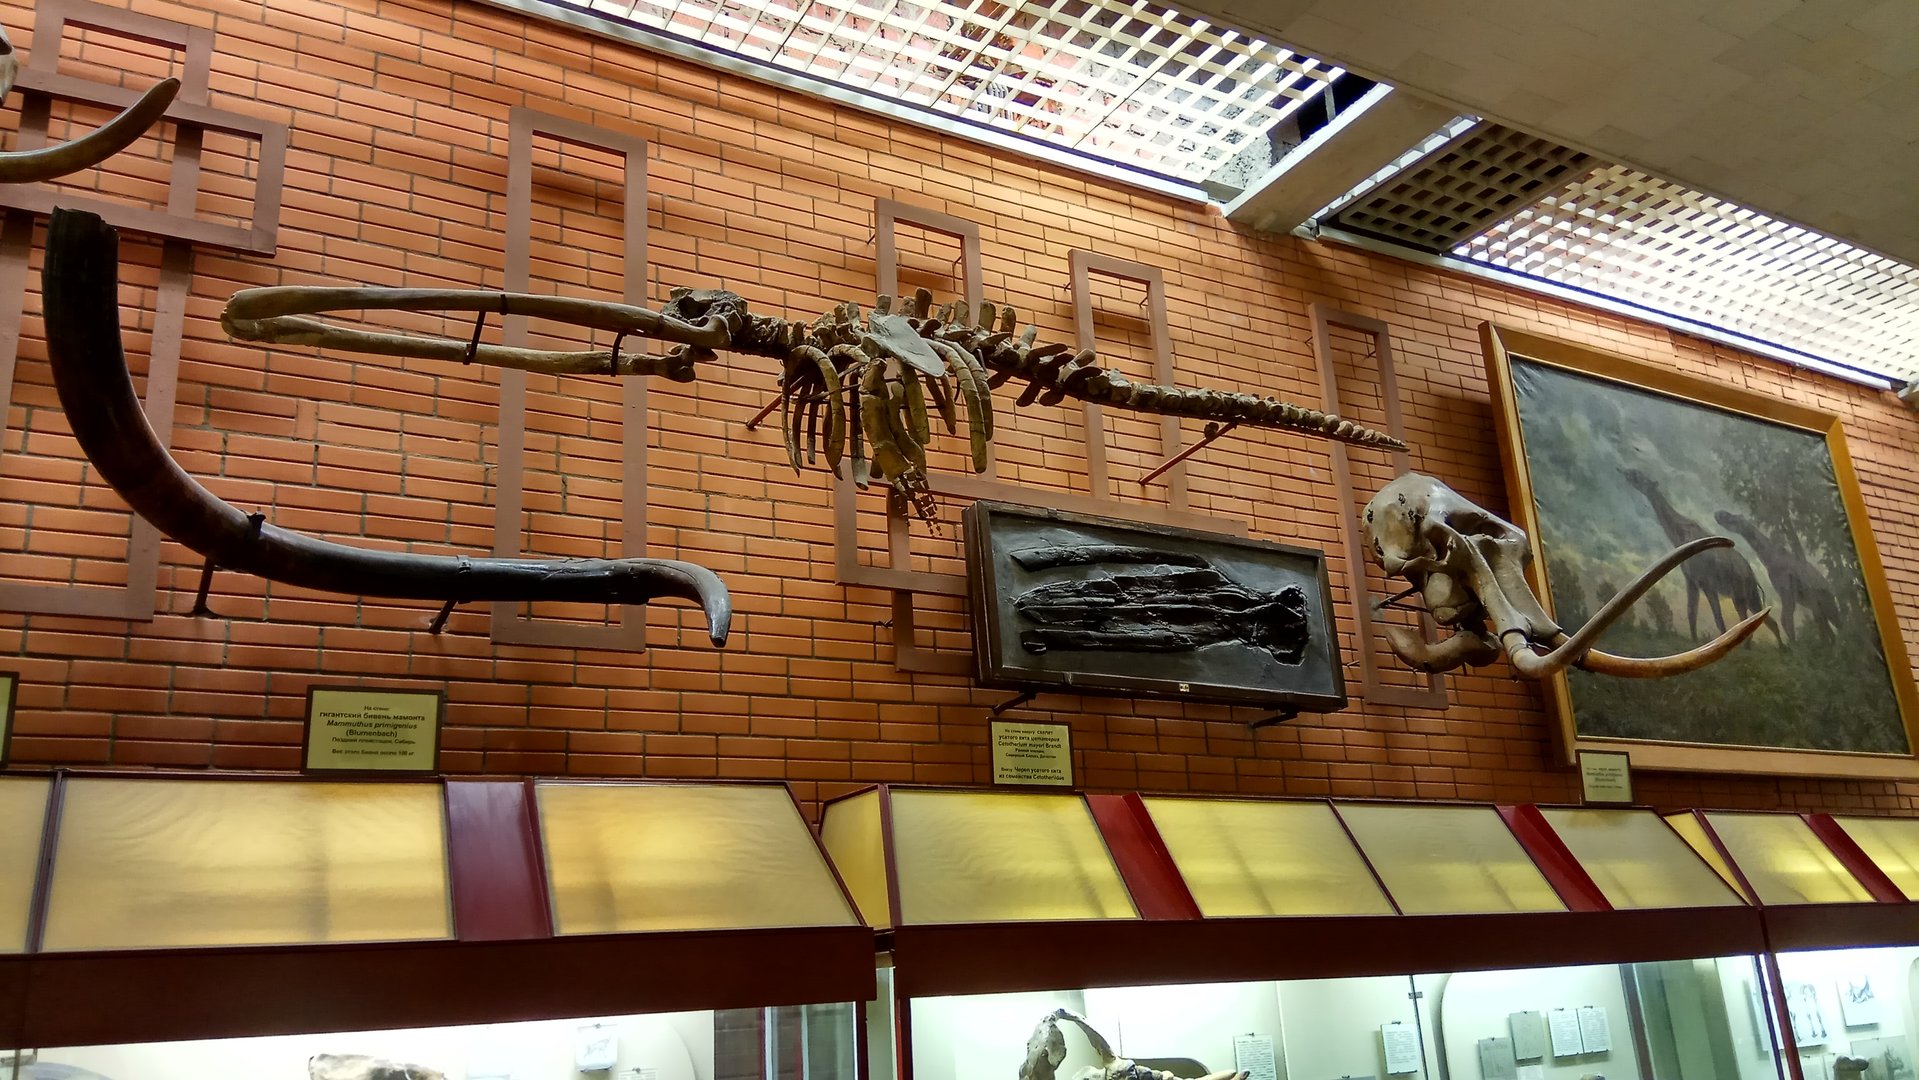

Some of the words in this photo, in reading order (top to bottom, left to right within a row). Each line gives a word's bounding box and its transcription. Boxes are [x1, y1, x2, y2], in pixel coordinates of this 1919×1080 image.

[363, 712, 391, 720] бивень
[327, 720, 372, 728] Mammuthus
[374, 722, 417, 730] primigenius
[346, 729, 398, 738] (Blumenbach)
